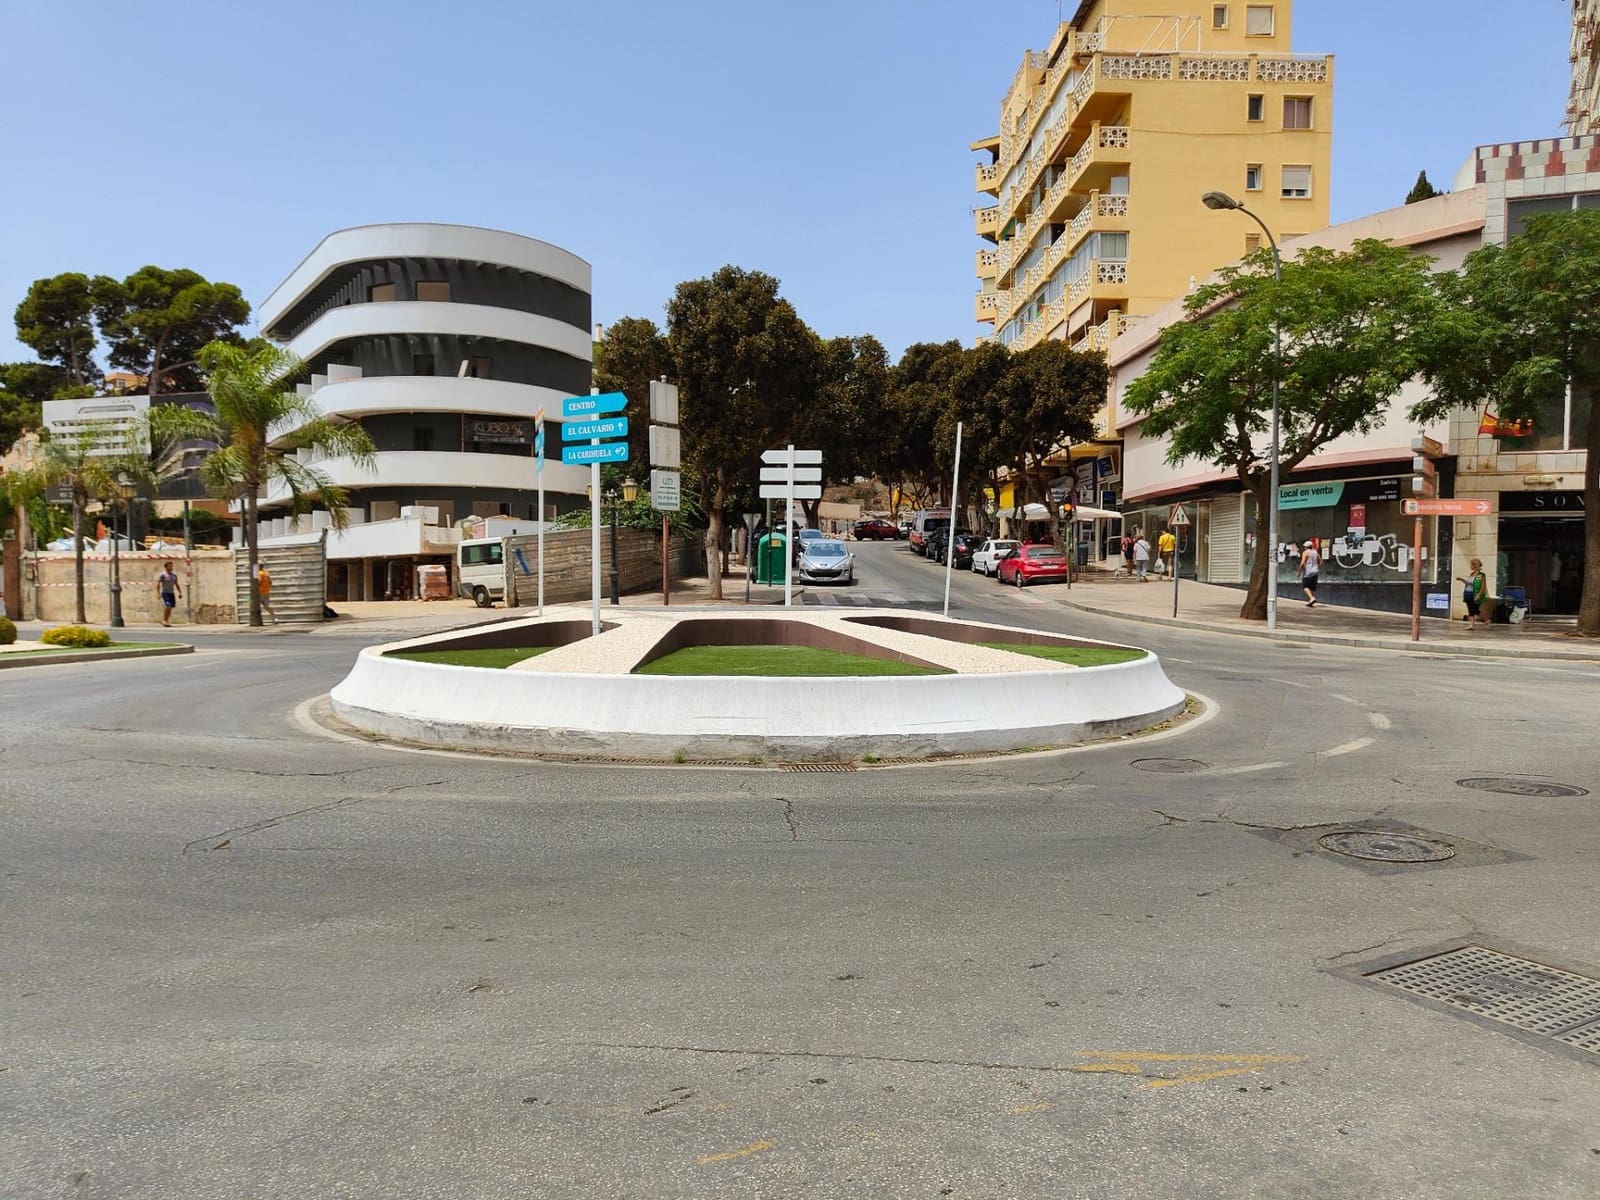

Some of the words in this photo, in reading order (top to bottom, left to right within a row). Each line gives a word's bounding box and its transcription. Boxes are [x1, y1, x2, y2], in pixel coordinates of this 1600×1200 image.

[568, 401, 596, 411] CENTRO
[568, 427, 577, 436] EL
[578, 423, 614, 435] CALVARIO
[568, 451, 577, 460] LA
[577, 448, 612, 459] CARIHUELA
[1280, 488, 1298, 498] Local
[1300, 489, 1310, 497] en
[1311, 486, 1333, 495] venta
